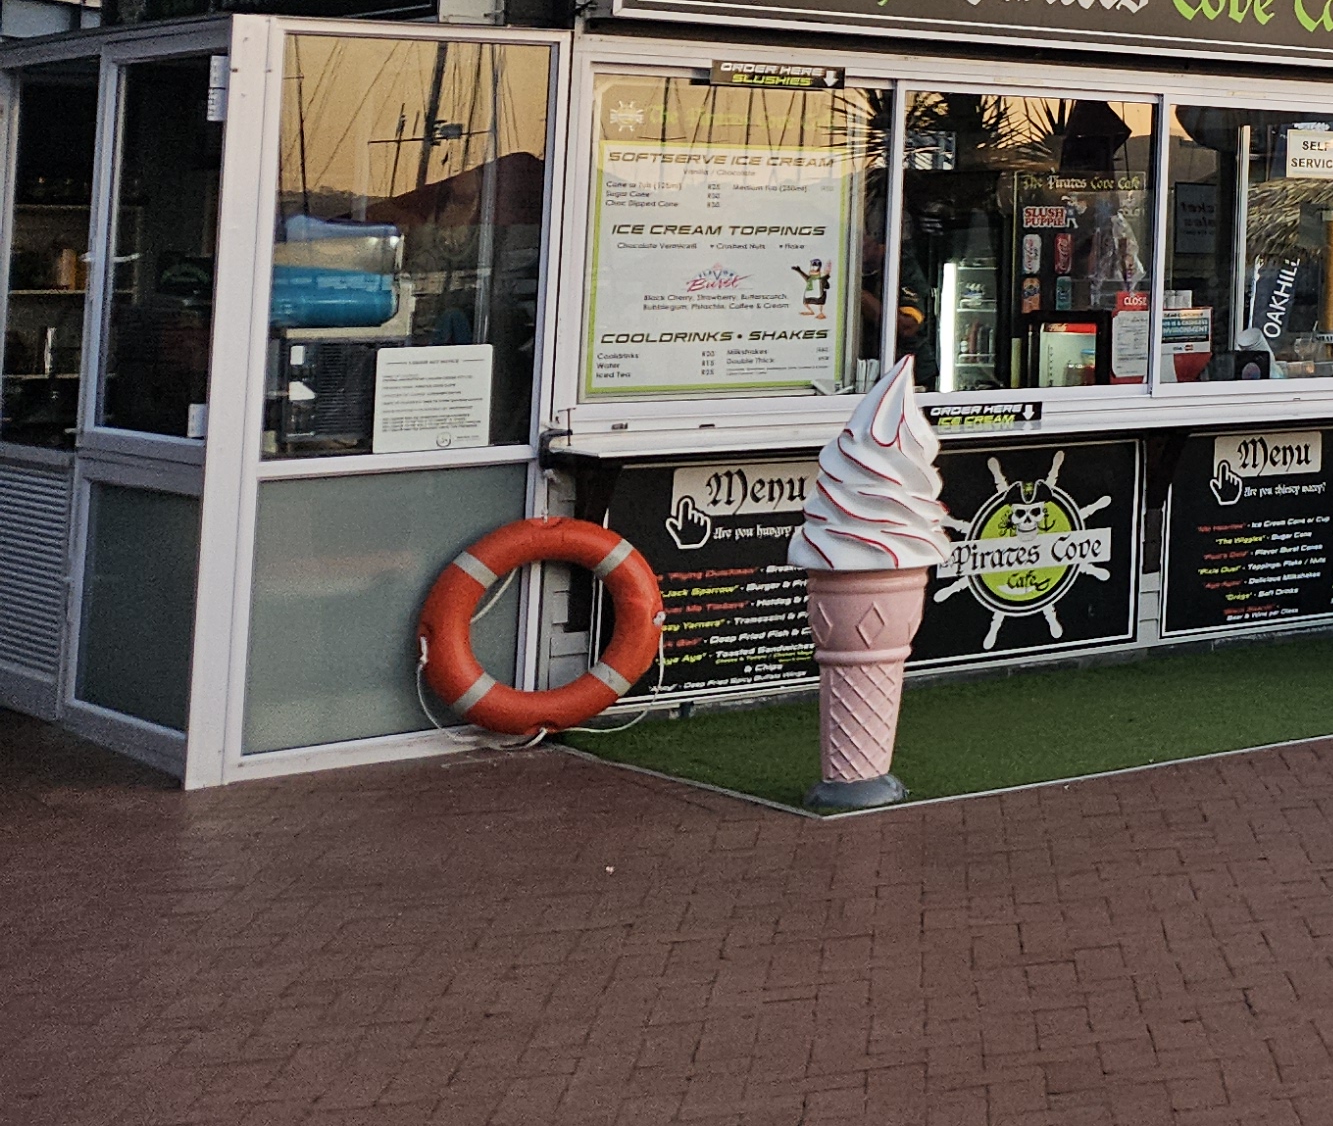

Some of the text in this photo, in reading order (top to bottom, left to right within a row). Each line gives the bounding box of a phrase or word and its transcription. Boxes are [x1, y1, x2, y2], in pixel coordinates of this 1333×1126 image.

[720, 62, 825, 76] ORDER HERE
[732, 74, 813, 86] SLUSHIES
[1302, 139, 1331, 152] SELF
[608, 151, 834, 168] SOFTSERVE ICE CREAM
[1047, 175, 1087, 190] Pirates
[1024, 207, 1066, 218] SLUSH
[1024, 217, 1066, 228] PUPPIE
[612, 225, 826, 236] ICE CREAM TOPPINGS
[686, 274, 752, 292] Burst
[600, 329, 828, 344] COOLDRINKS SHAKES
[930, 404, 1023, 416] ORDER HERE
[938, 414, 1015, 426] ICE CREAM
[1237, 436, 1312, 477] Menu
[705, 469, 809, 514] Menu
[951, 535, 1102, 575] Pirates Cove
